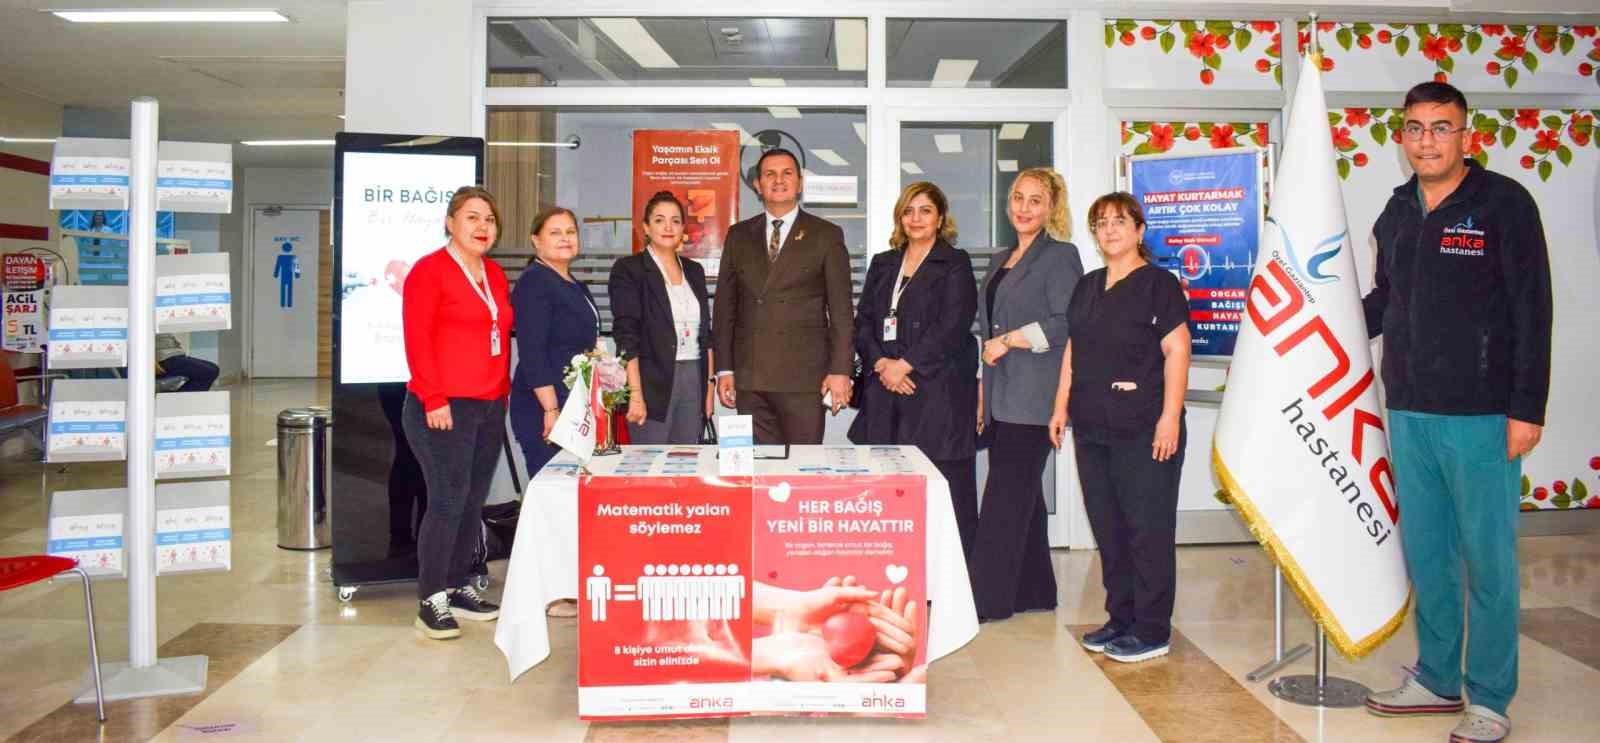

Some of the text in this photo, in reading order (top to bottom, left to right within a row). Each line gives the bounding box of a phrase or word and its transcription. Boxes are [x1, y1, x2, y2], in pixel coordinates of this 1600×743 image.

[652, 145, 720, 155] Yaşamın Eksik
[652, 156, 688, 166] Parçası
[364, 185, 393, 203] BİR
[1144, 189, 1243, 203] HAYAT KURTARMAK
[1149, 202, 1239, 215] ARTIK ÇOK KOLAY
[1440, 235, 1485, 249] anka
[1440, 247, 1484, 256] hastanesi
[6, 256, 37, 265] DAYAN
[1210, 290, 1245, 298] ORGAN
[6, 305, 37, 316] ŞARJ
[23, 325, 37, 335] TL
[1197, 323, 1239, 331] KURTARI
[1281, 397, 1391, 547] hastanesi
[597, 503, 730, 519] Matematik yalan
[799, 496, 884, 518] HER BAĞIŞ
[629, 521, 702, 537] söylemez
[767, 517, 914, 533] YENİ BİR HAYATTIR
[614, 646, 621, 655] 8
[623, 645, 652, 656] kişiye
[654, 646, 684, 655] umut
[633, 655, 700, 667] sizin elinizde
[689, 695, 733, 709] anka
[861, 693, 905, 708] anka
